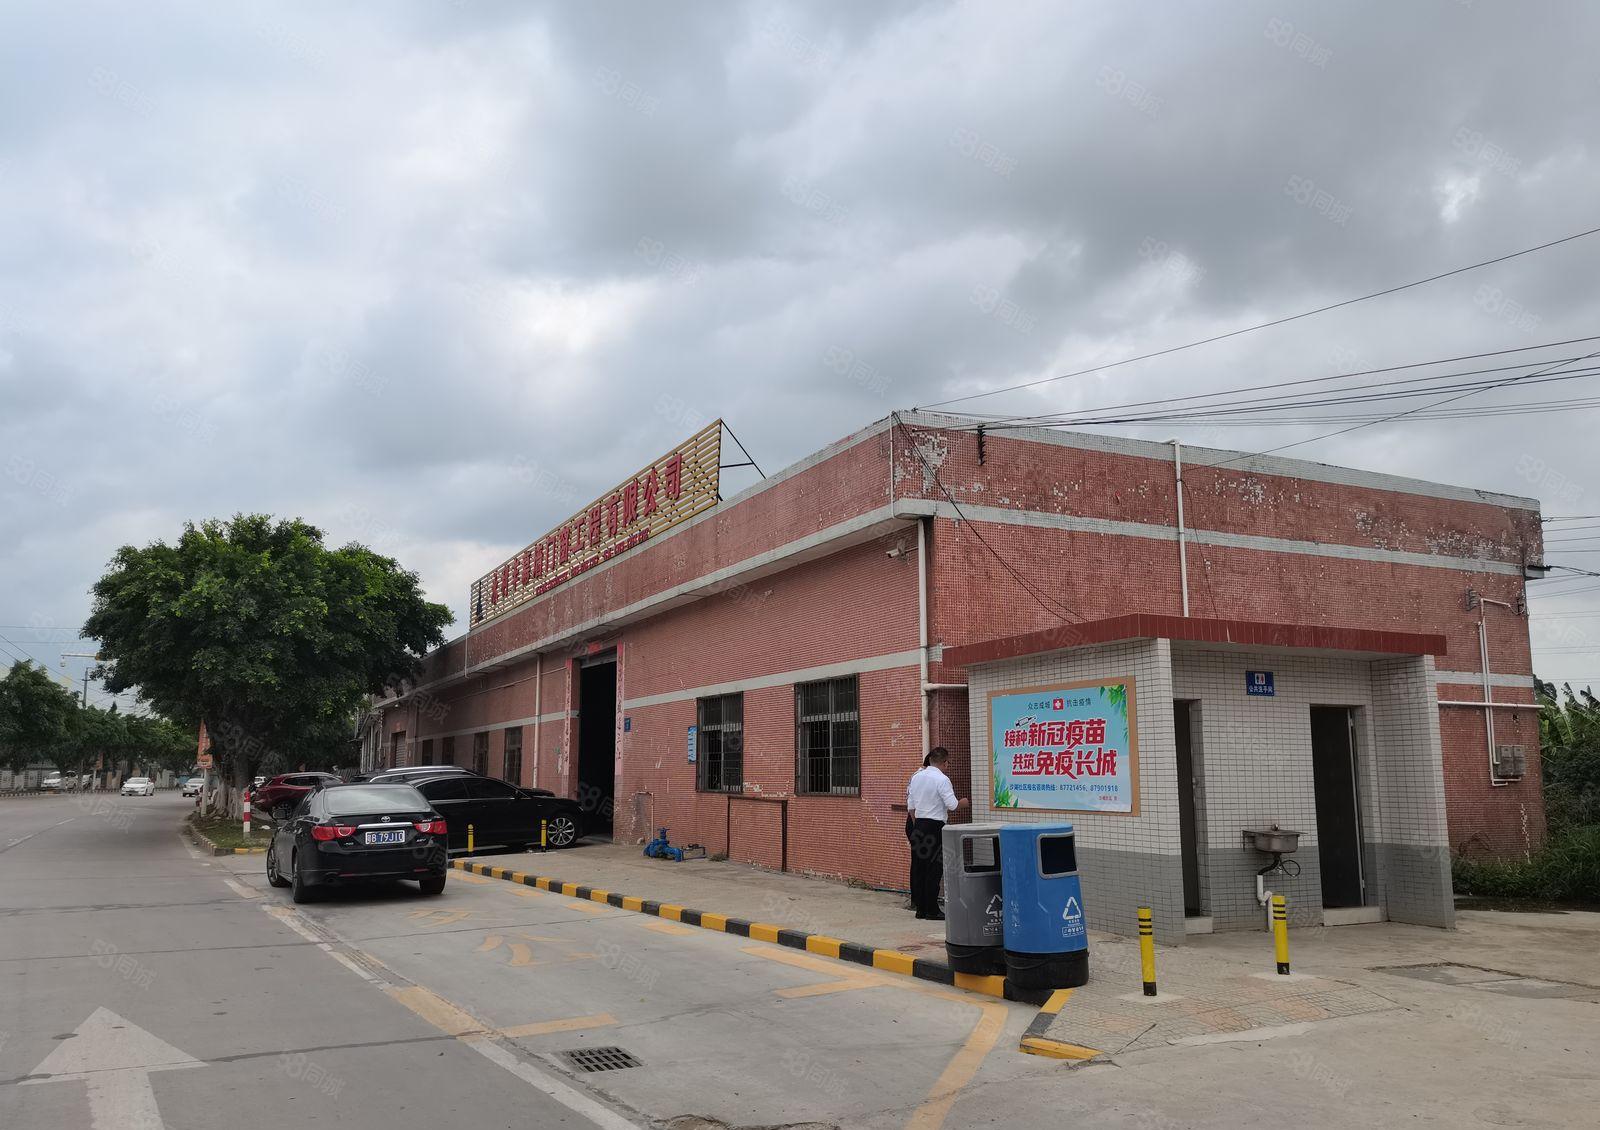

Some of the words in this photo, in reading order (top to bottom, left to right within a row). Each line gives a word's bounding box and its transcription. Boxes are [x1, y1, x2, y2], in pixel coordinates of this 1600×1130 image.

[1027, 701, 1050, 711] 众志成城
[1067, 697, 1091, 708] 抗击疫情
[1004, 718, 1106, 749] 接种新冠疫苗
[1012, 748, 1117, 779] 共筑免疫长城
